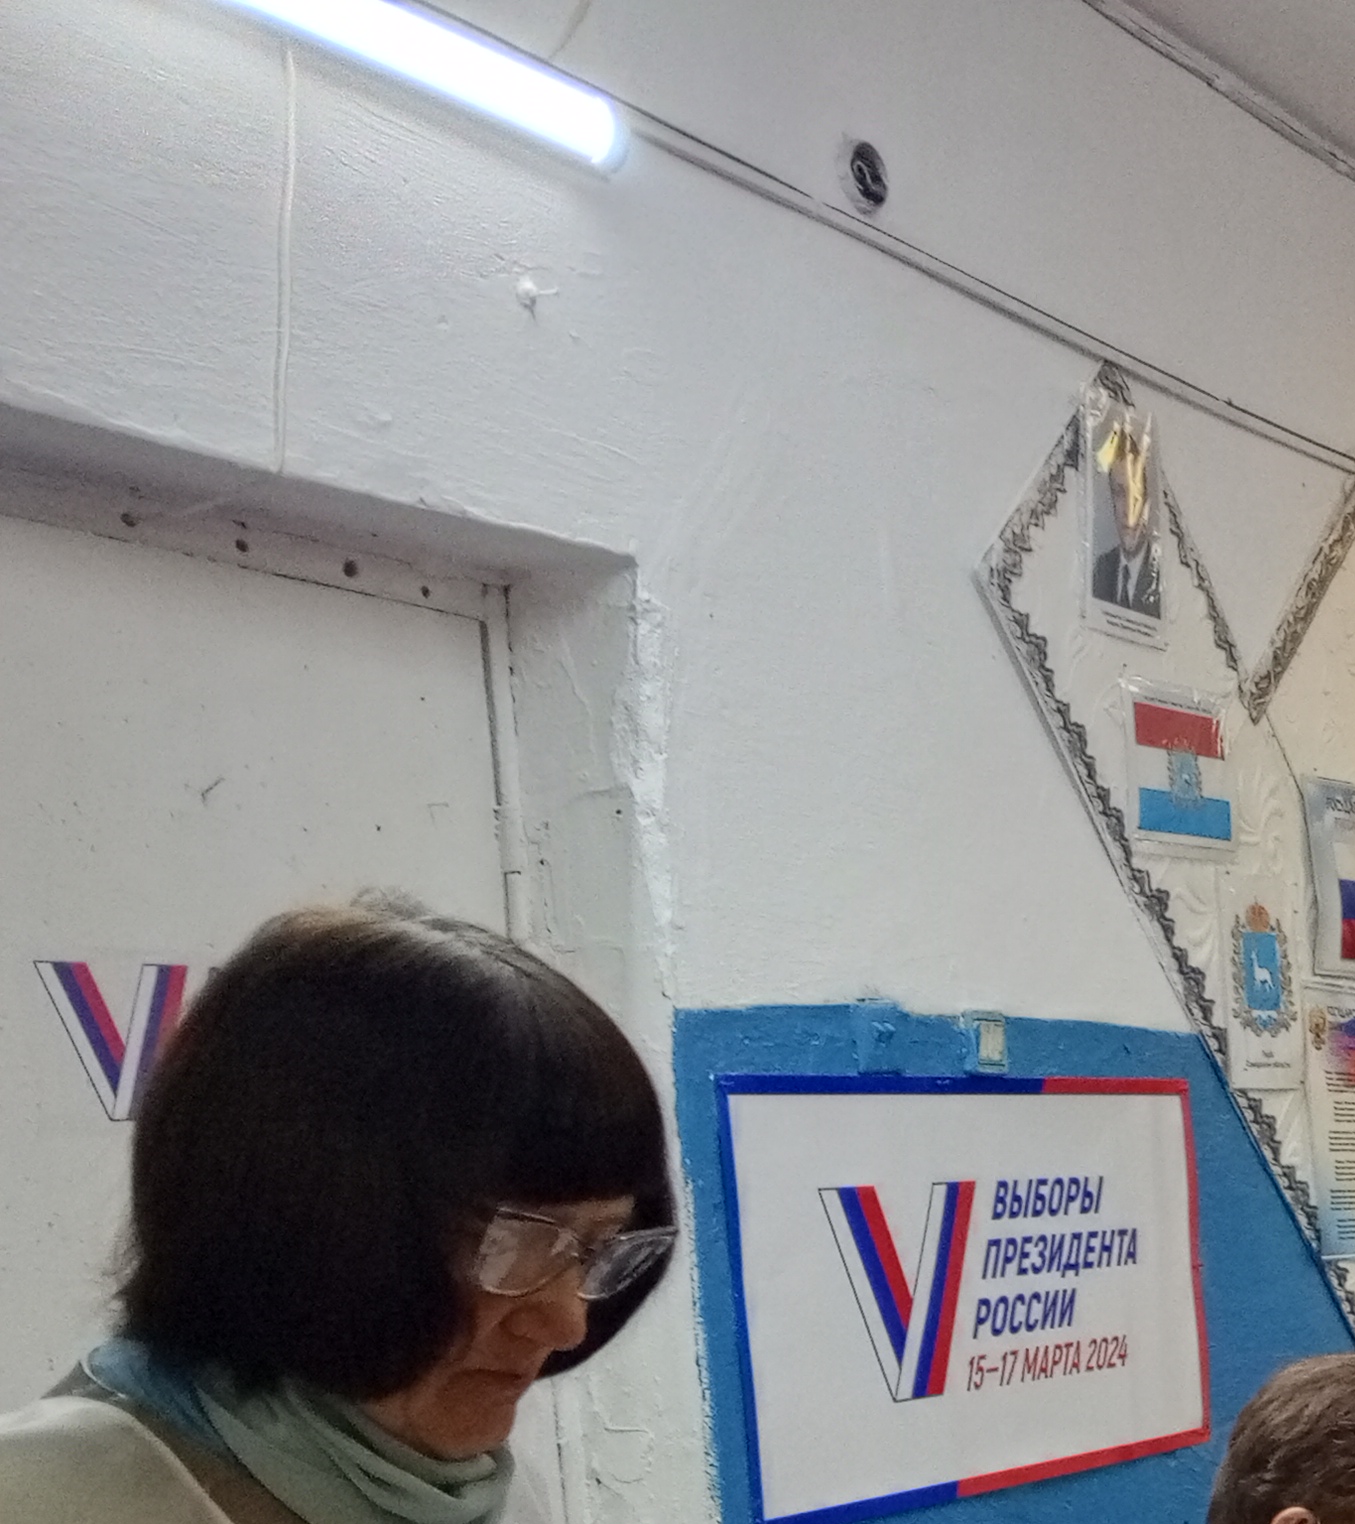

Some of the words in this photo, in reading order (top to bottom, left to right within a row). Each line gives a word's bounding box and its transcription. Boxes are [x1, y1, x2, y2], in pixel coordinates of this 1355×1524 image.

[991, 1175, 1104, 1221] ВЫБОРЫ
[982, 1227, 1138, 1280] ПРЕЗИДЕНТА
[973, 1287, 1077, 1340] РОССИИ
[1021, 1339, 1081, 1383] МАРТА
[1085, 1334, 1128, 1373] 2024
